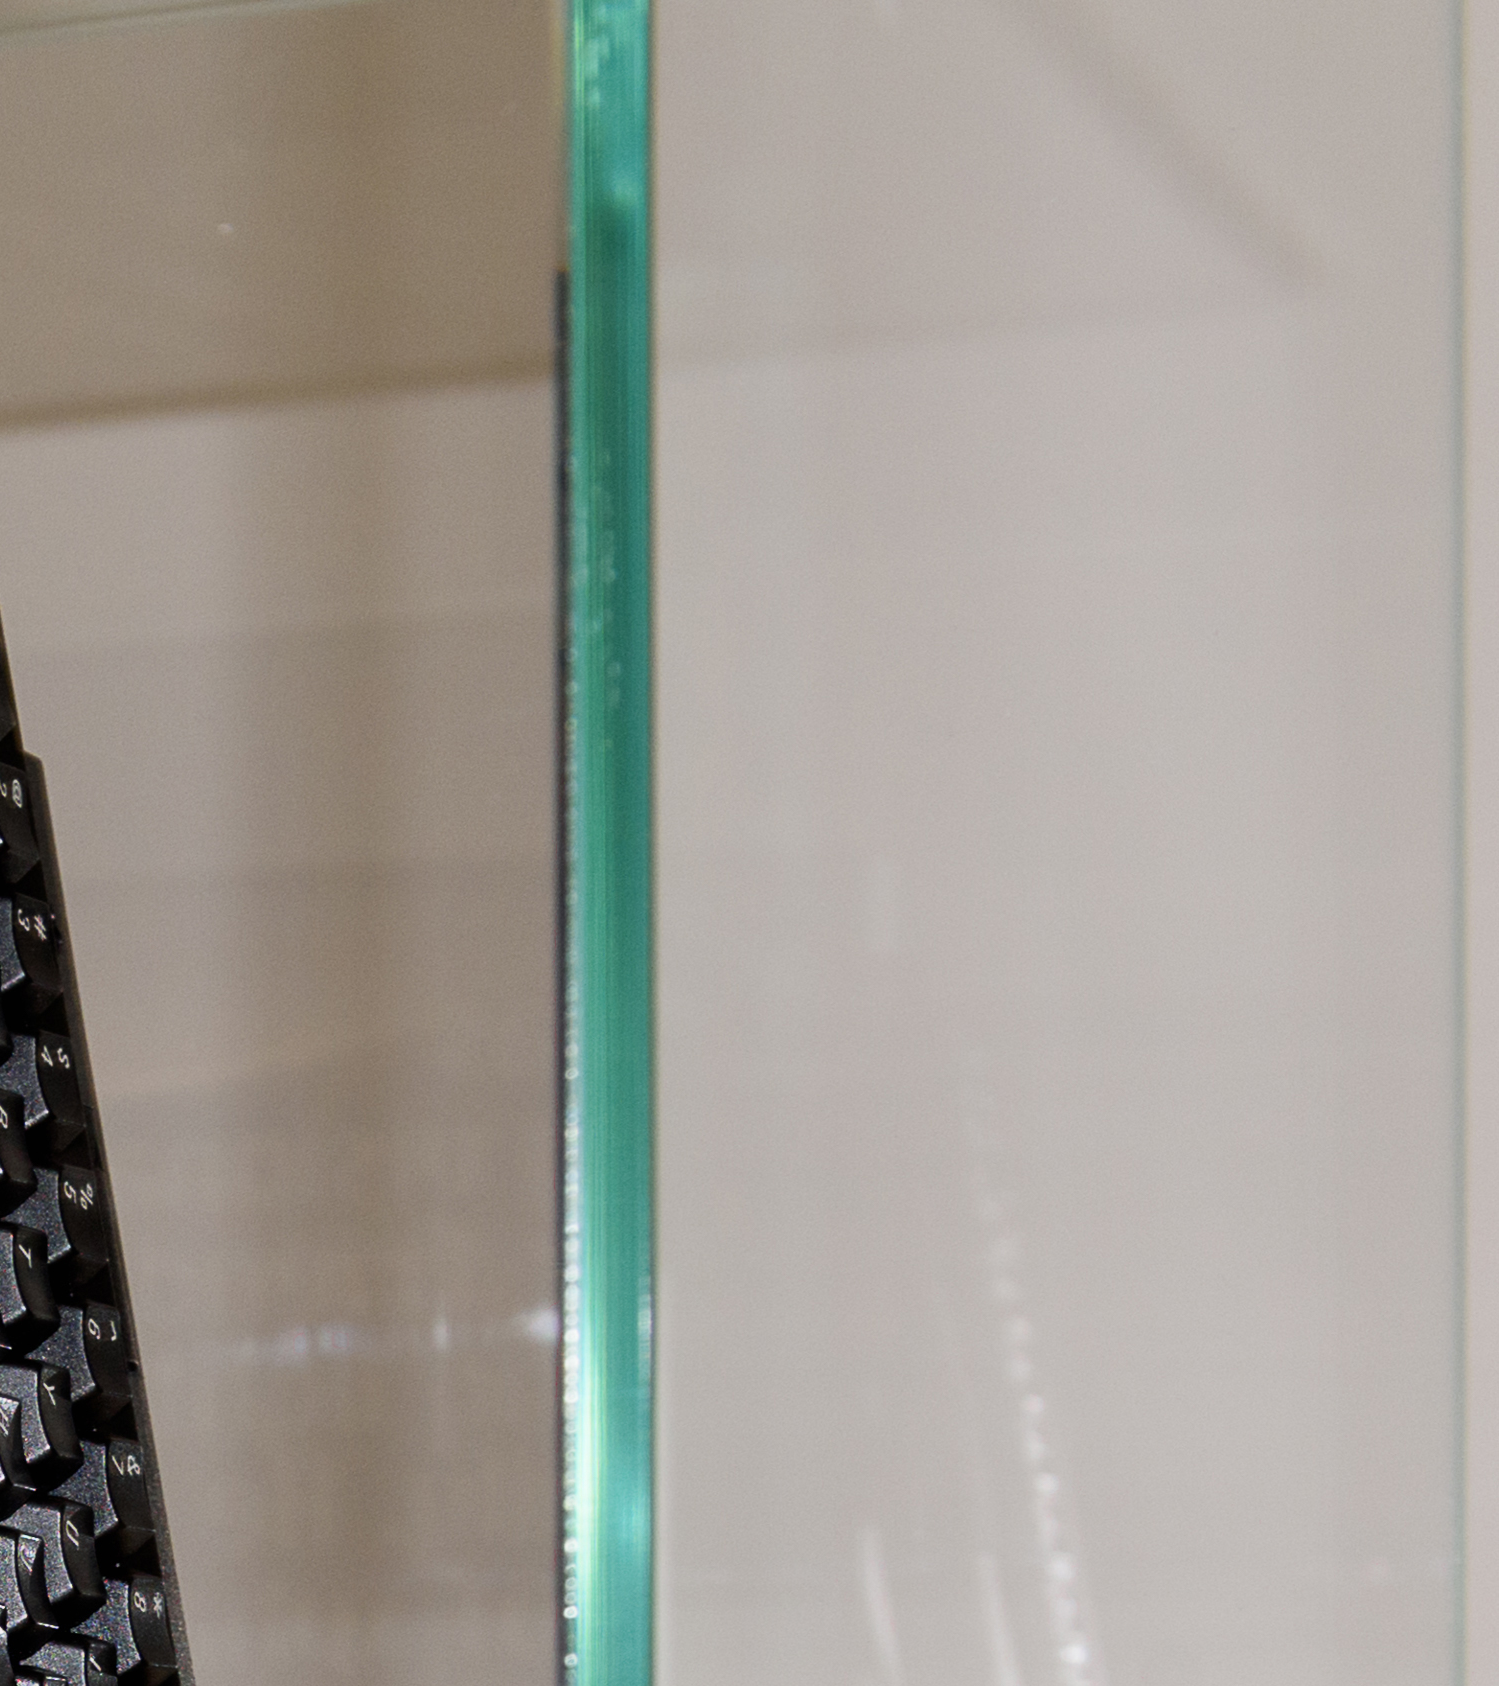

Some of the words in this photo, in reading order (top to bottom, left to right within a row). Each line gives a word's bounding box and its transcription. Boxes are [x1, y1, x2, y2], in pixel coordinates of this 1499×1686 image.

[17, 909, 31, 932] 3
[40, 1045, 54, 1067] 4
[63, 1181, 78, 1205] 5
[88, 1317, 101, 1340] 6
[133, 1591, 147, 1613] 8
